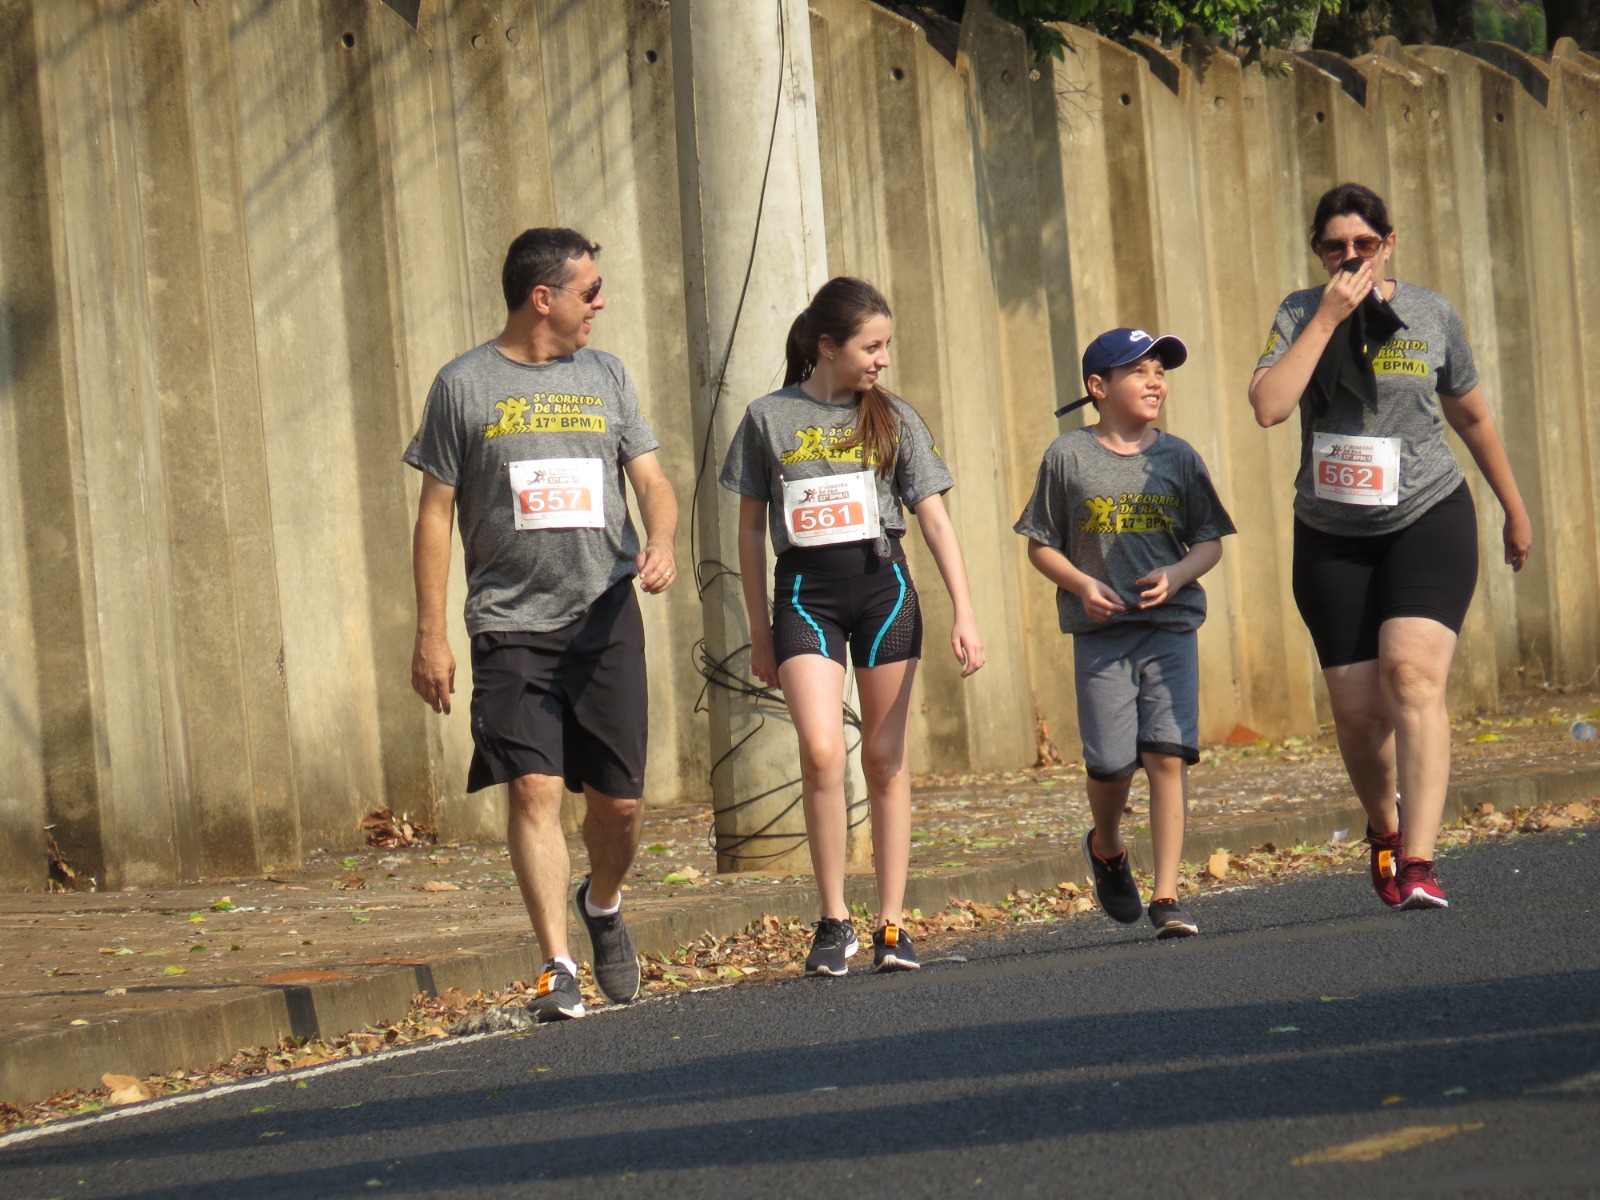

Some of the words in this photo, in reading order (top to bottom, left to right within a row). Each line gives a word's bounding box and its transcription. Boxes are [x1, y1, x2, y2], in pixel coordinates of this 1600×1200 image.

[1377, 349, 1405, 358] RUA
[547, 393, 604, 406] CORRIDA
[534, 404, 551, 413] DE
[554, 404, 581, 414] RUA
[1325, 464, 1374, 488] 562
[528, 489, 581, 512] 557
[1120, 504, 1137, 514] DE
[800, 504, 851, 530] 561
